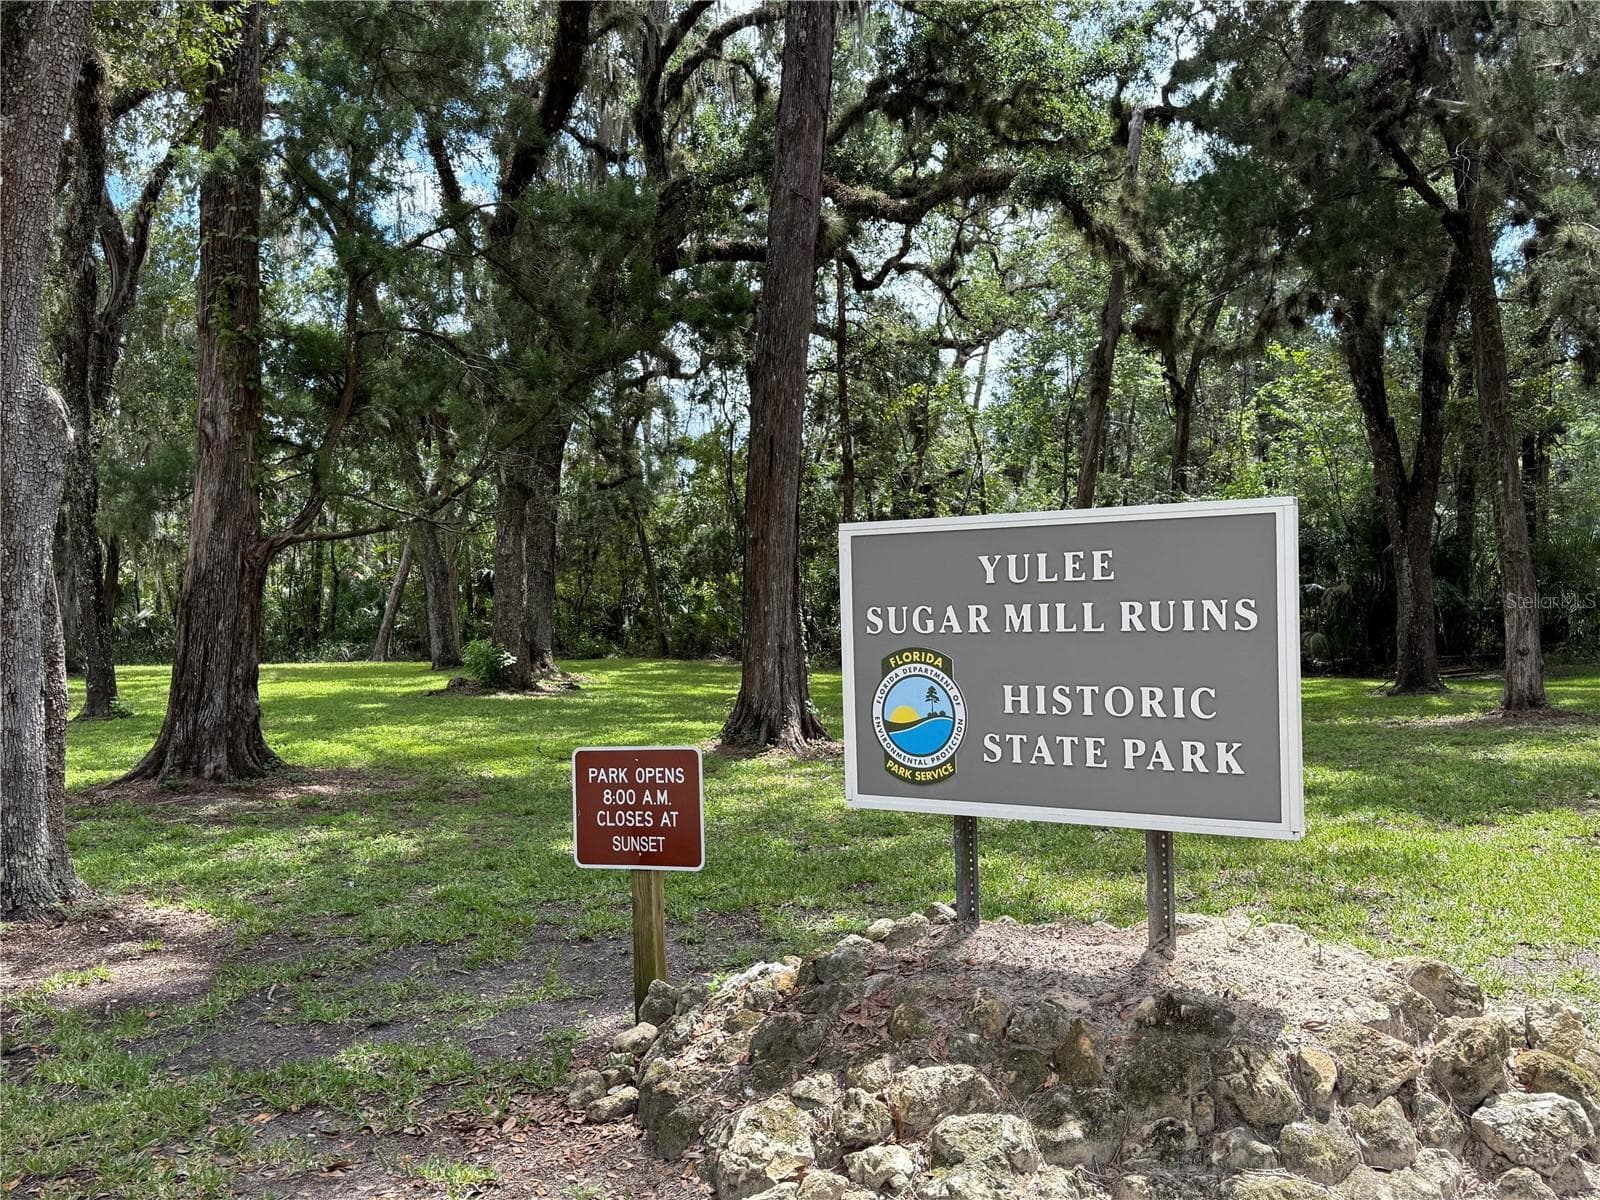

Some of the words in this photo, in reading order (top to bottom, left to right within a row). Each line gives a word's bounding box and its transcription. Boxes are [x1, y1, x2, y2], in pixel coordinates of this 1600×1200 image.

[978, 550, 1115, 584] YULEE
[865, 604, 991, 635] SUGAR
[1004, 602, 1105, 633] MILL
[1120, 599, 1258, 632] RUINS
[889, 651, 943, 668] FLORIDA
[876, 673, 900, 704] FLORIDA
[902, 666, 954, 692] DEPARTMENT
[953, 694, 961, 706] OF
[1002, 684, 1218, 720] HISTORIC
[875, 716, 928, 765] ENVIRONMENTAL
[931, 718, 963, 764] PROTECTION
[983, 734, 1107, 768] STATE
[1123, 738, 1246, 775] PARK
[588, 768, 628, 783] PARK
[635, 767, 685, 783] OPENS
[887, 760, 912, 779] PARK
[915, 763, 954, 781] SERVICE
[603, 789, 636, 805] 8:00
[642, 789, 672, 805] A.M.
[596, 811, 653, 827] CLOSES
[660, 811, 679, 828] AT
[612, 836, 665, 852] SUNSET
